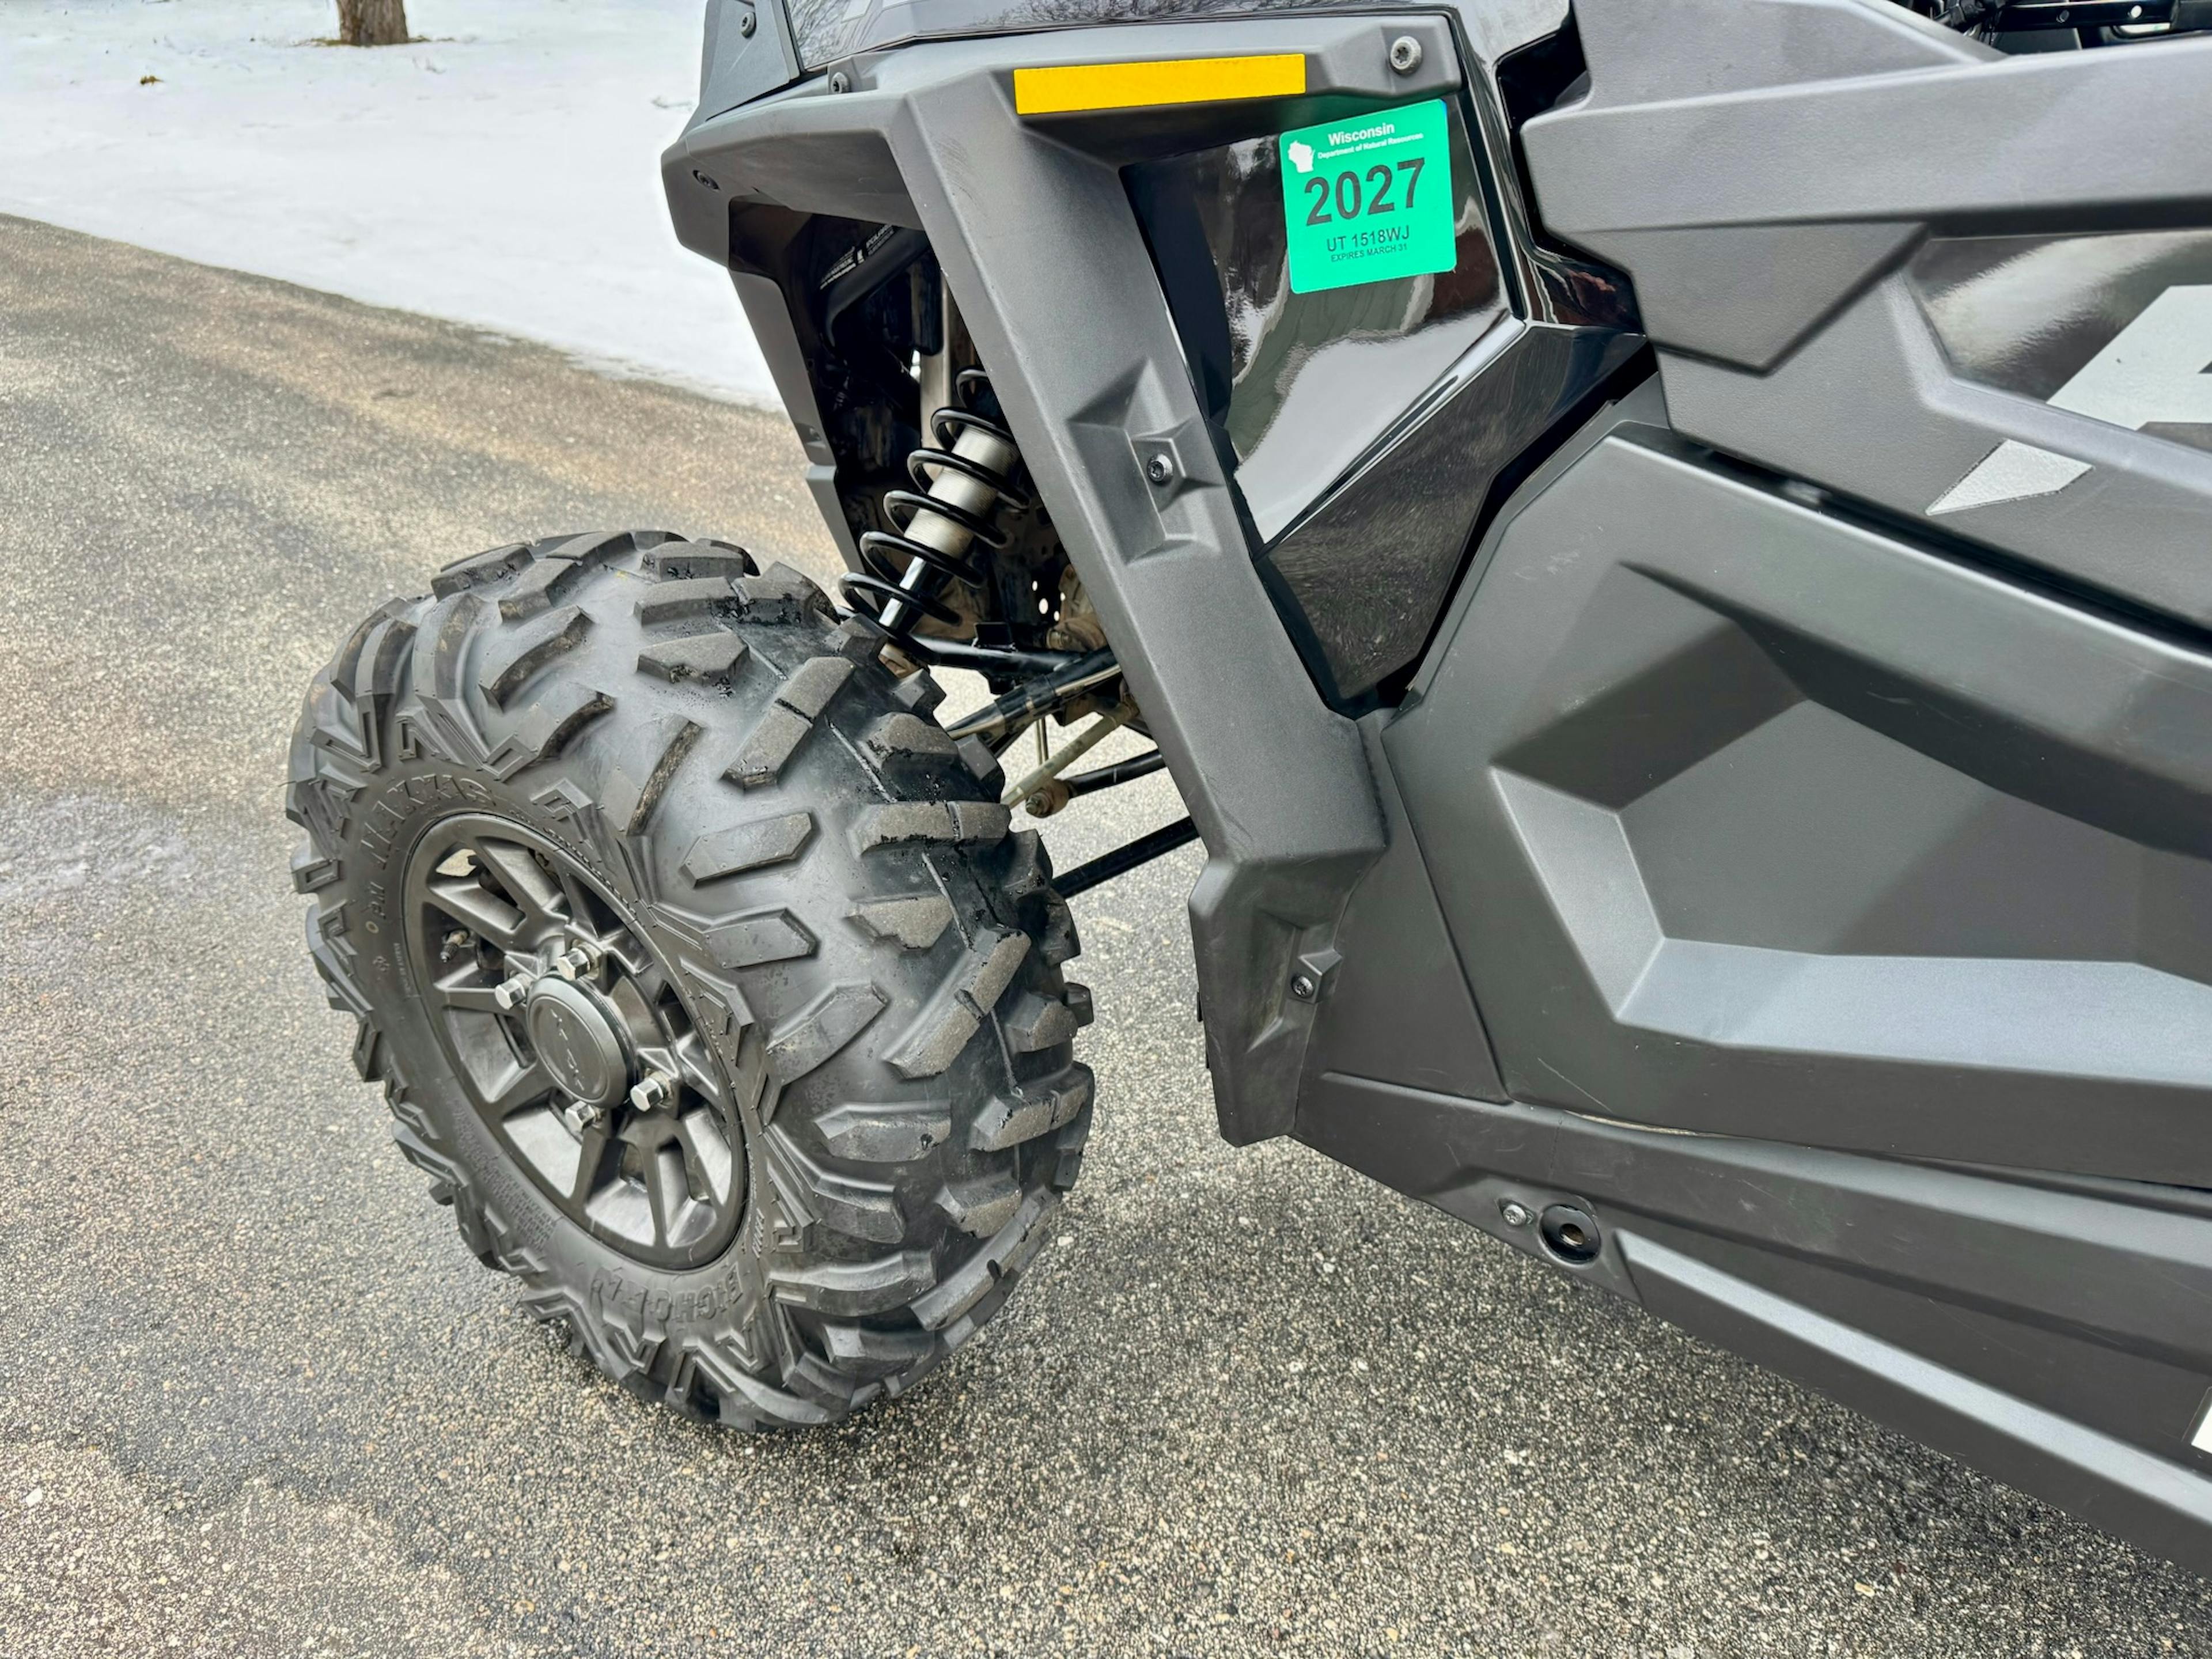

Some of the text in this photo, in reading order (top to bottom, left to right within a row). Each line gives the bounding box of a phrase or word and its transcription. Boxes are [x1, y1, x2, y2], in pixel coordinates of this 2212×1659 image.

[1317, 146, 1355, 159] Department
[1363, 139, 1387, 150] Natural
[1388, 133, 1424, 145] Resources
[1328, 123, 1395, 146] Wisconsin
[1304, 157, 1425, 226] 2027
[1327, 225, 1410, 252] UT 1518WJ
[1331, 243, 1407, 262] EXPIRES MARCH 31
